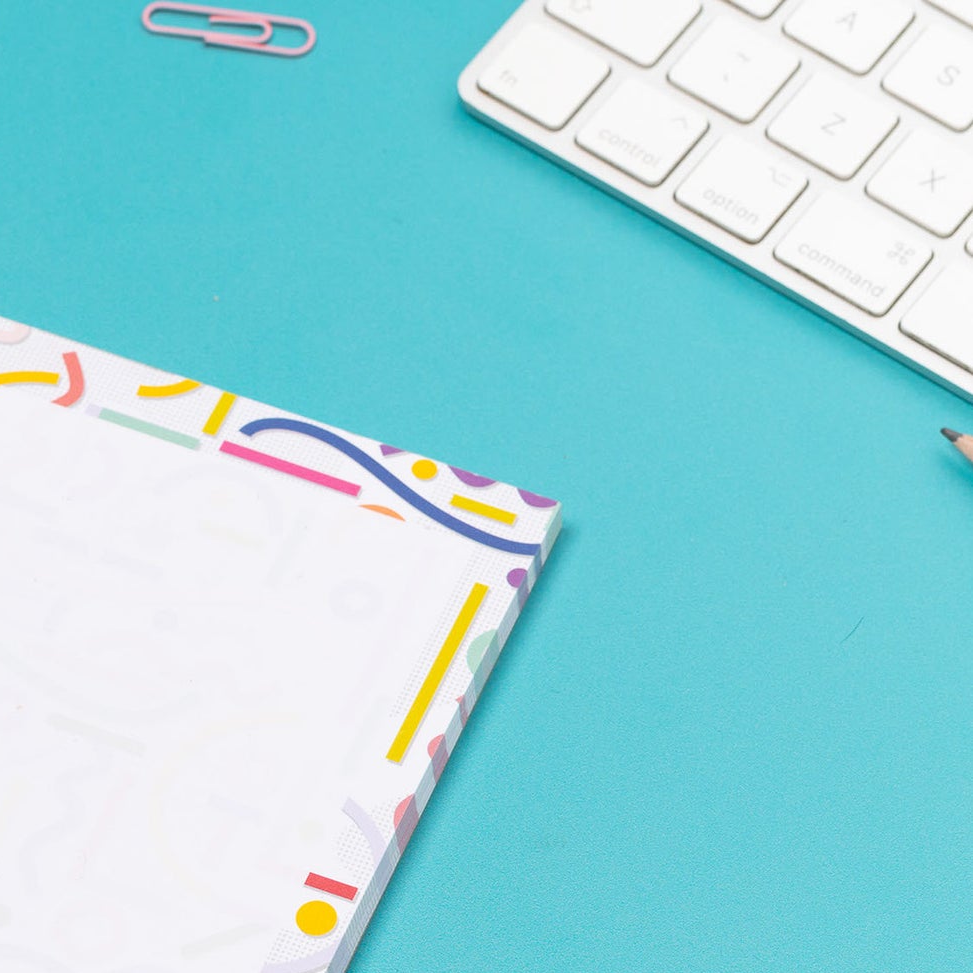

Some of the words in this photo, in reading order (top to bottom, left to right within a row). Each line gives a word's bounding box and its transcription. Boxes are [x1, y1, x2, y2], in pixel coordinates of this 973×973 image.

[937, 65, 961, 87] S
[820, 112, 848, 136] Z
[598, 127, 663, 169] control
[919, 168, 947, 193] X
[702, 187, 760, 226] option
[797, 241, 886, 298] command
